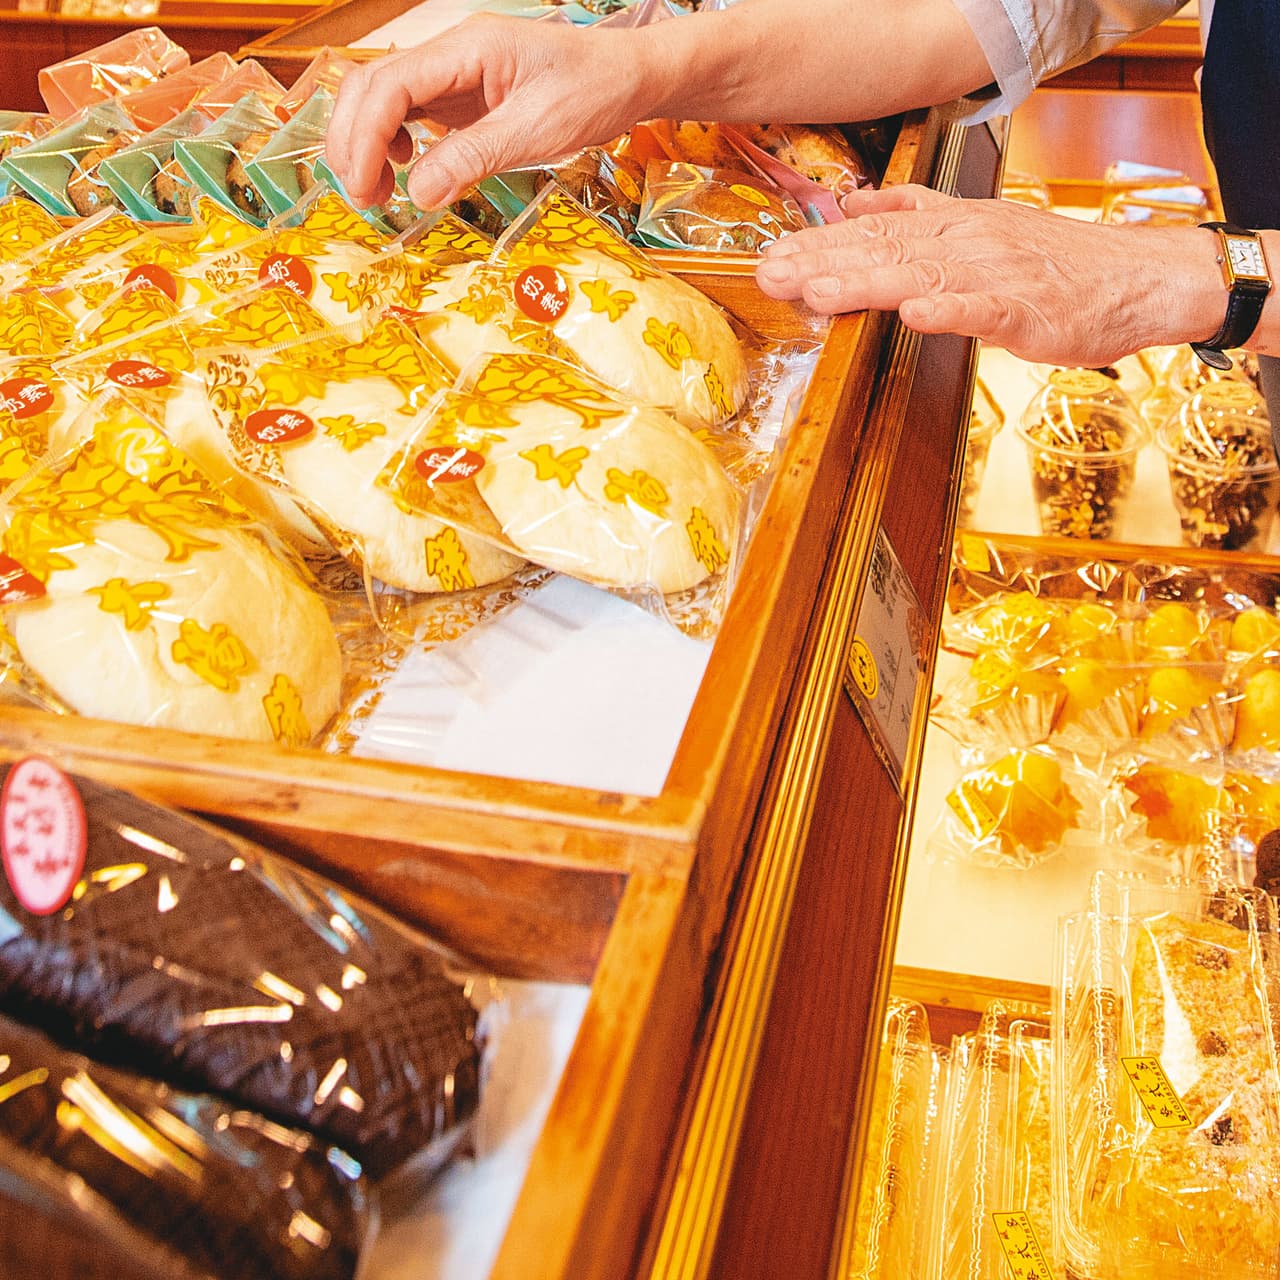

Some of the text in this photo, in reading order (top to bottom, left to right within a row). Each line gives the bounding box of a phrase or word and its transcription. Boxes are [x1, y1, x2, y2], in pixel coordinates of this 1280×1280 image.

[522, 274, 565, 317] 奶素
[117, 365, 165, 387] 奶素
[256, 412, 306, 443] 奶素
